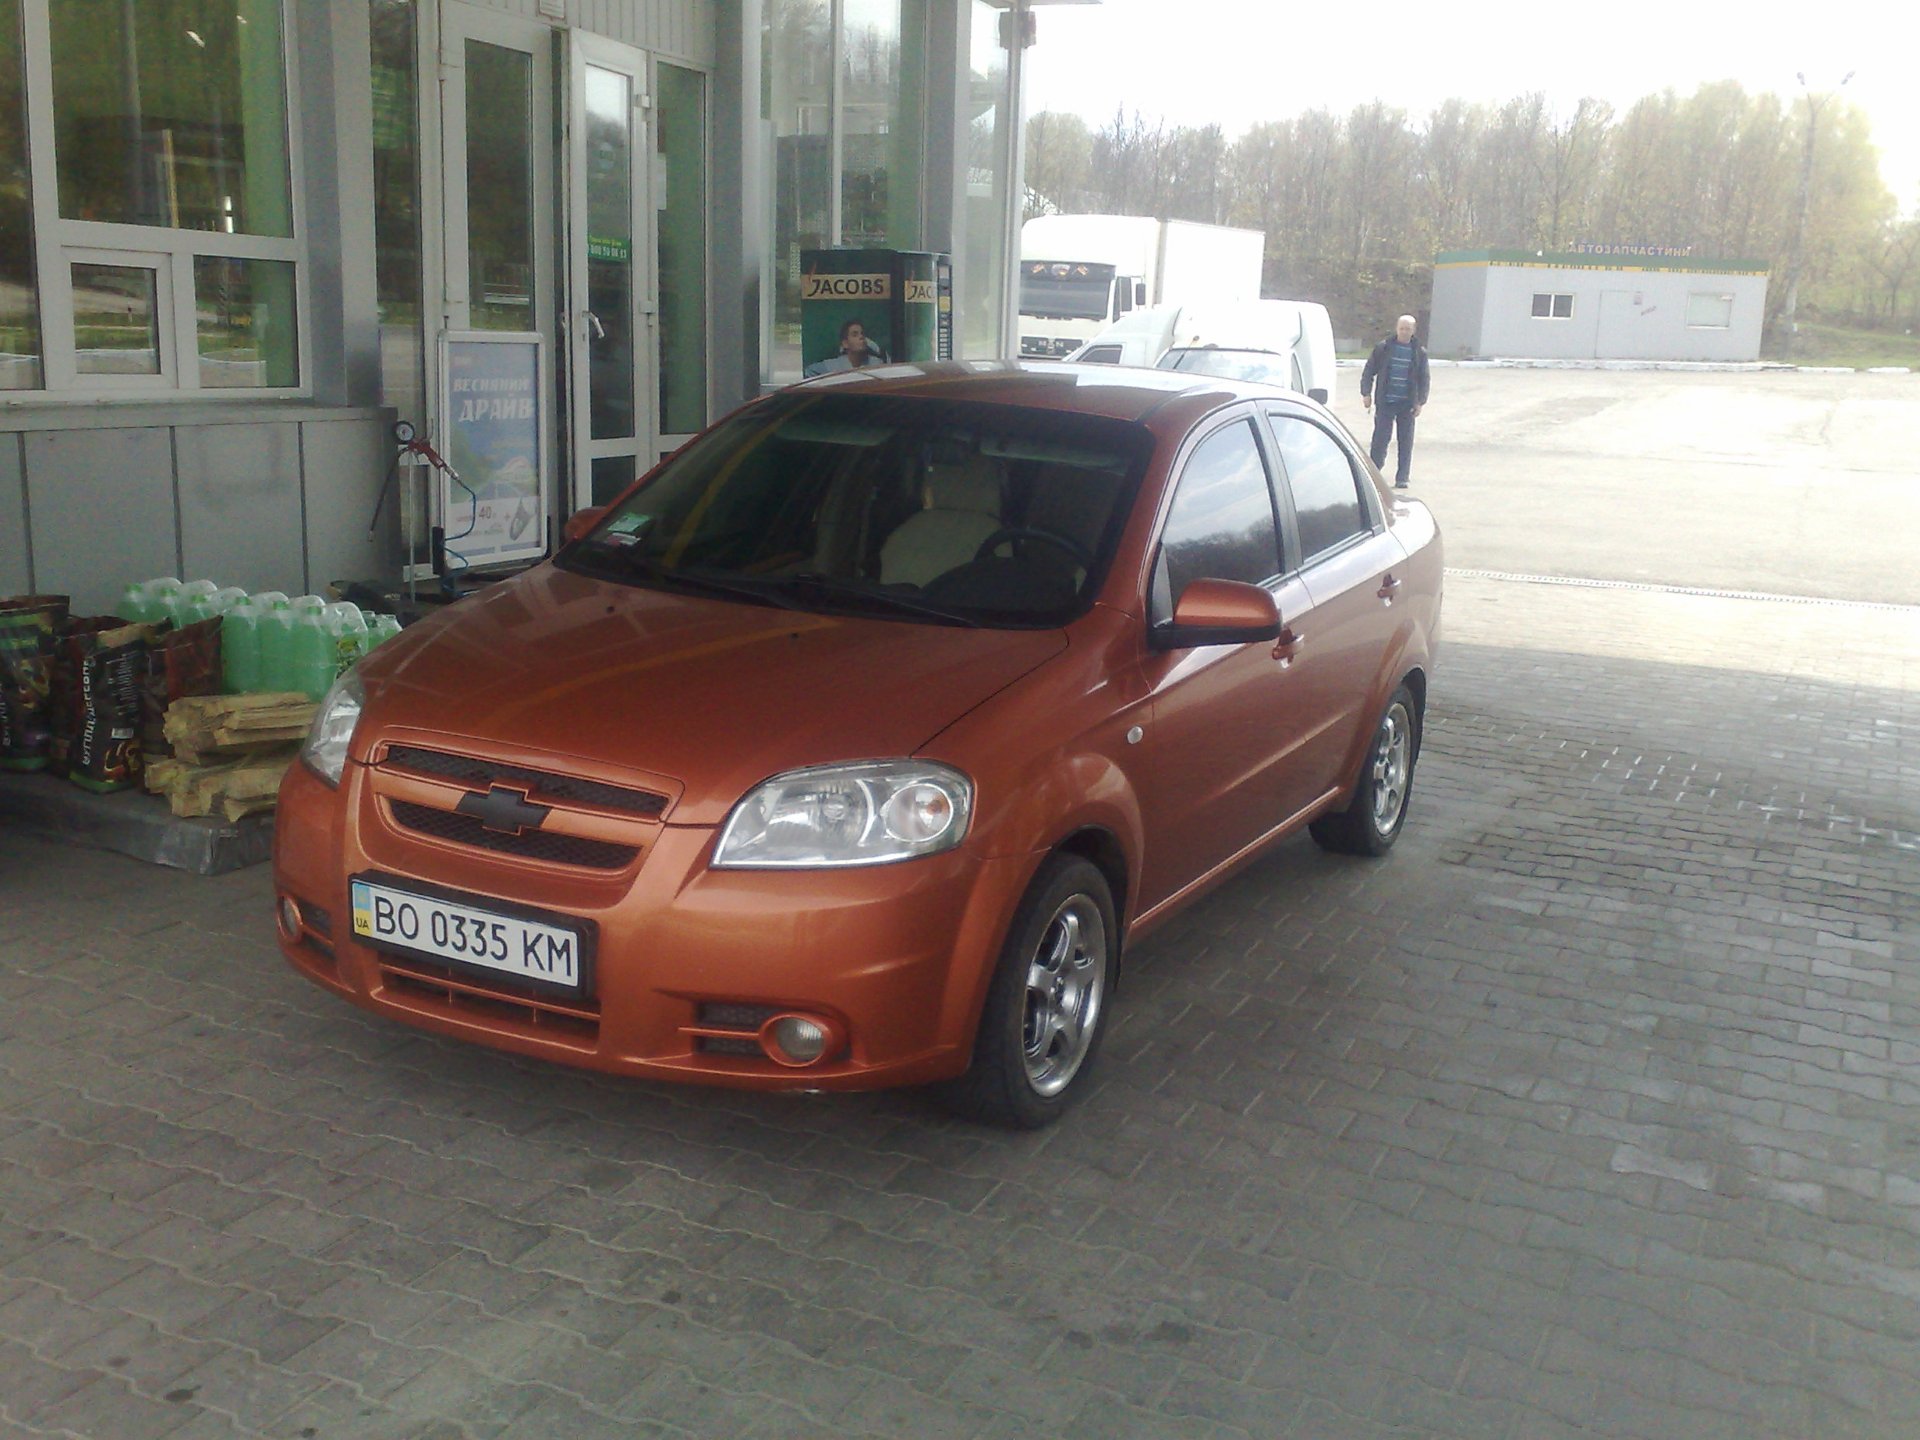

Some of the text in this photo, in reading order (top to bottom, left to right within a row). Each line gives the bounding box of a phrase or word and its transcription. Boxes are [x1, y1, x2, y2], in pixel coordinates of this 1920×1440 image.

[1568, 243, 1691, 257] АВТОЗАПЧАСТИНИ
[808, 279, 884, 297] JACOBS
[458, 395, 534, 422] ДРАЙВ
[355, 916, 370, 931] UA
[374, 896, 572, 977] BO 0335 KM
